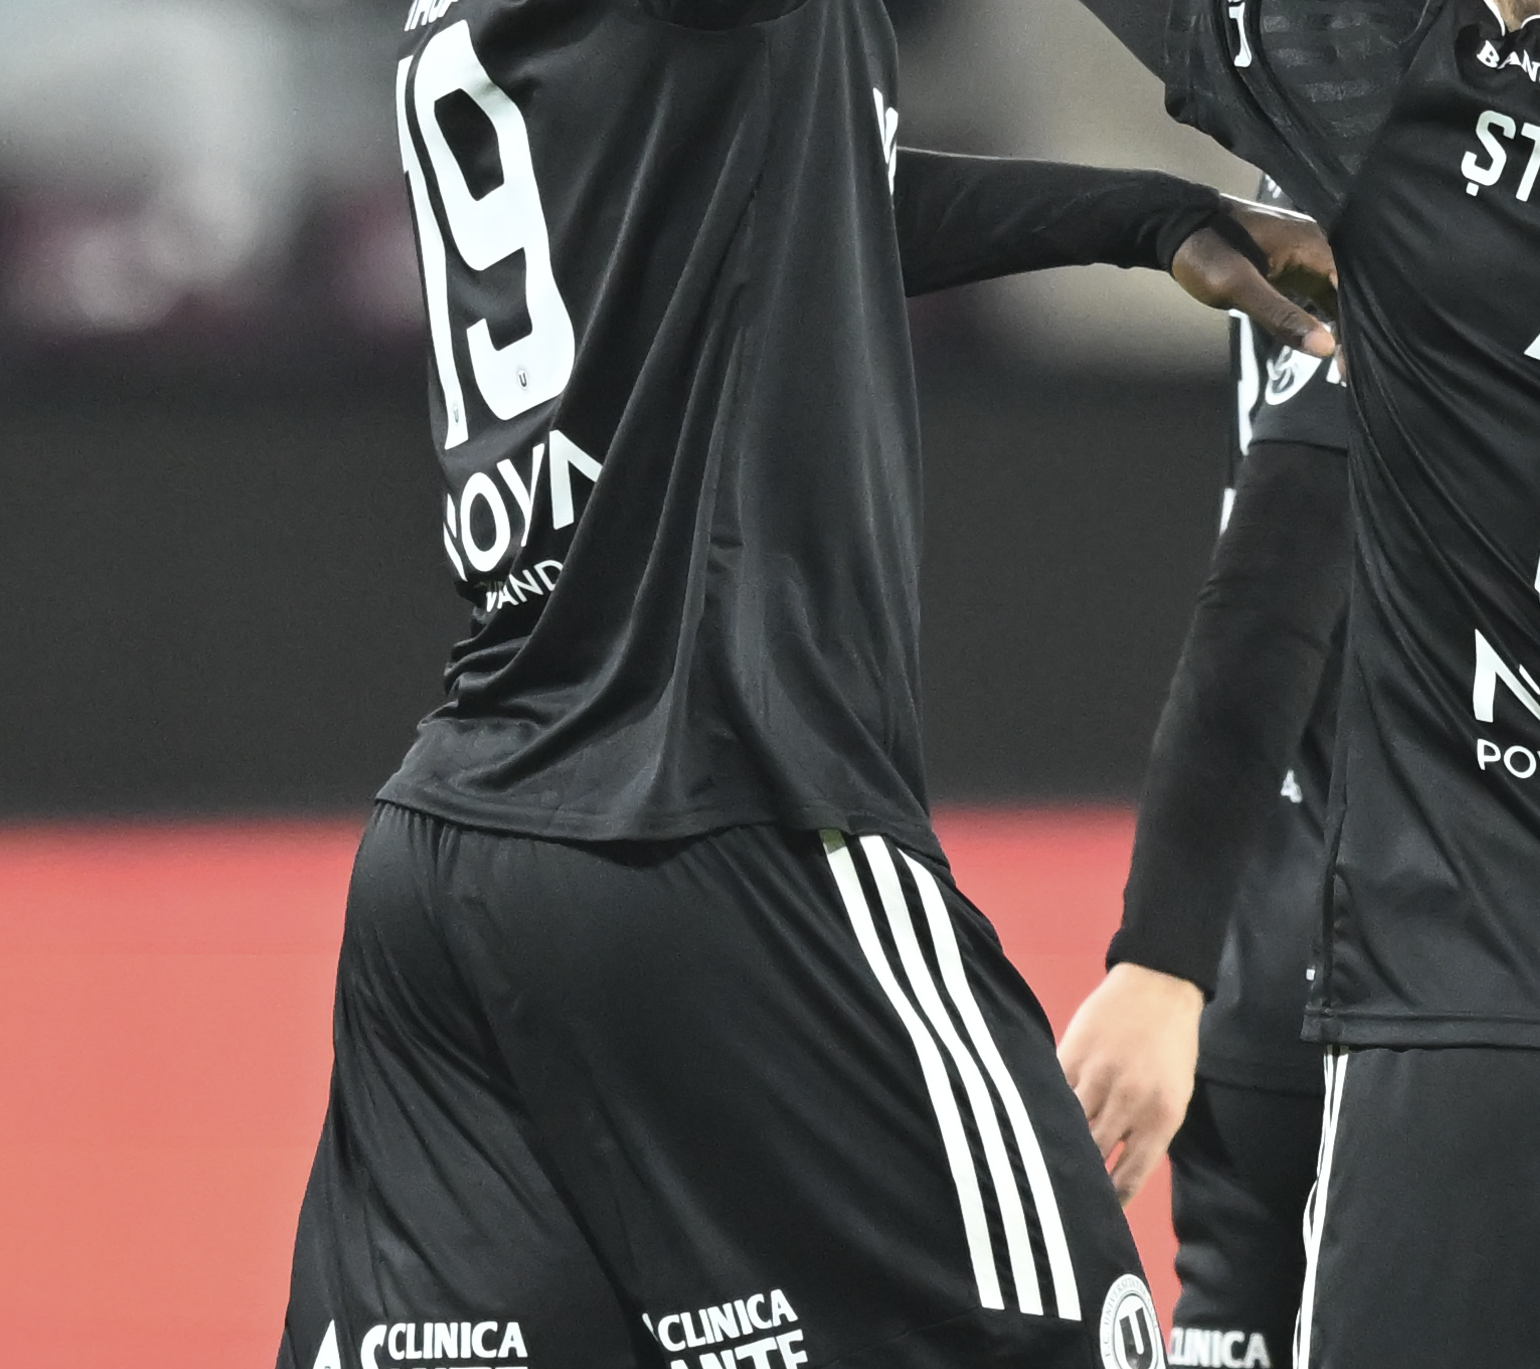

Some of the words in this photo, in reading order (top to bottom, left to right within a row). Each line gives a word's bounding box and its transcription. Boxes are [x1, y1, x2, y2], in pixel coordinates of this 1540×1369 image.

[396, 19, 576, 450] 19
[388, 1320, 528, 1360] CLINICA
[657, 1288, 798, 1352] CLINICA
